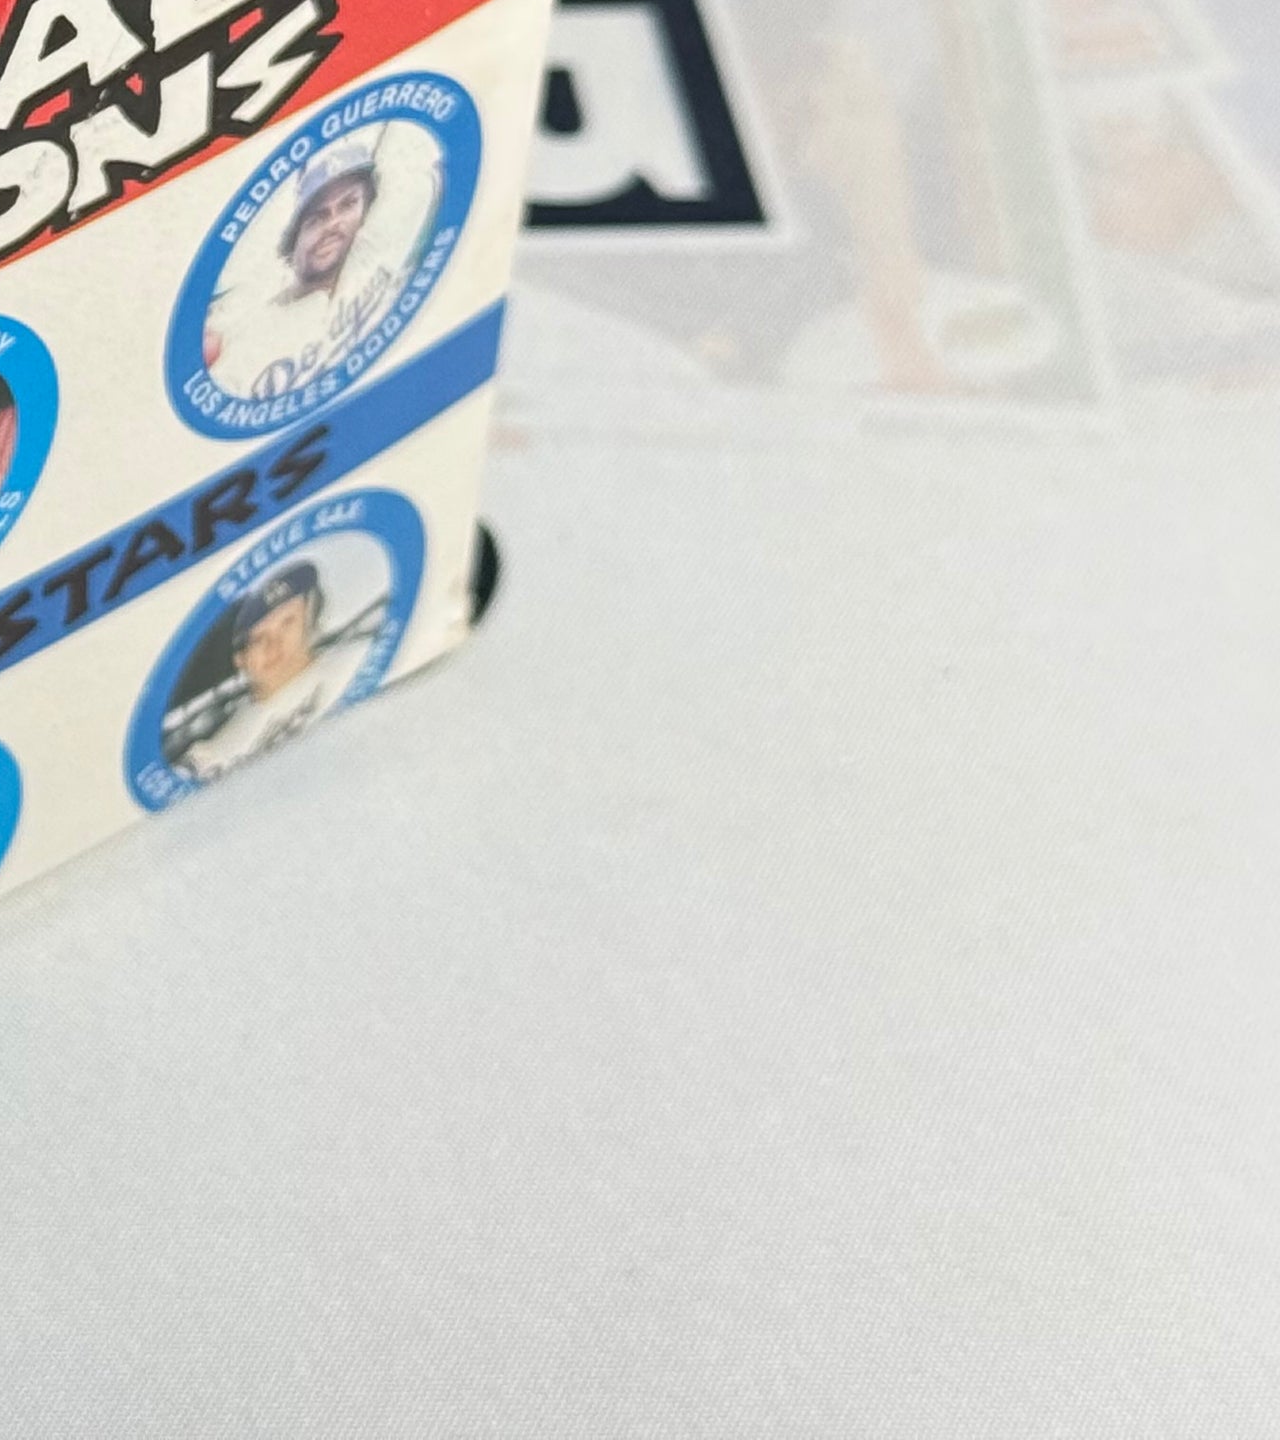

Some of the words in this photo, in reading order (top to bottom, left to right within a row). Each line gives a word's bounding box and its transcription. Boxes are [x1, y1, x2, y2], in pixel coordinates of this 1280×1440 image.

[221, 137, 312, 244] PEDRO
[320, 81, 458, 139] GUERRERO
[183, 368, 214, 416] LOS
[220, 371, 340, 427] ANGELES
[346, 226, 457, 377] DODGERS
[217, 514, 308, 601] STEVE
